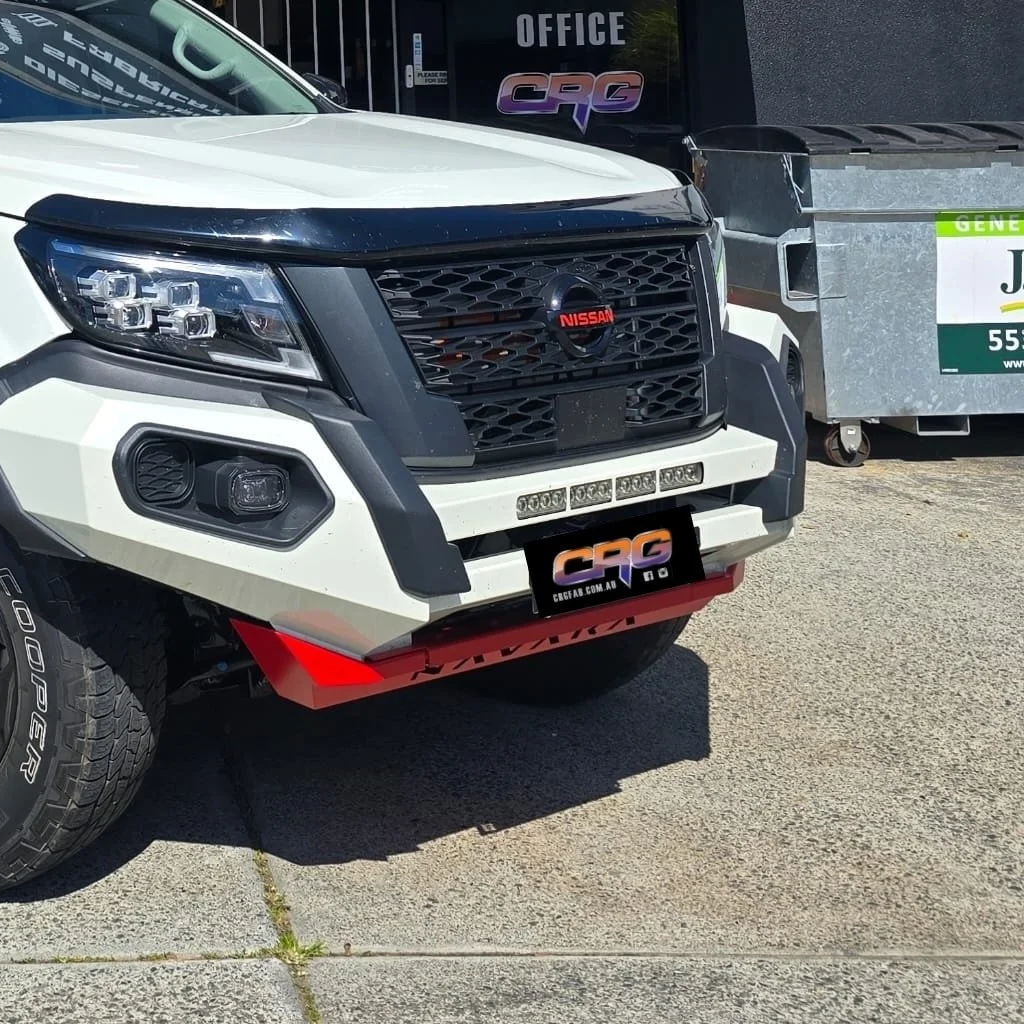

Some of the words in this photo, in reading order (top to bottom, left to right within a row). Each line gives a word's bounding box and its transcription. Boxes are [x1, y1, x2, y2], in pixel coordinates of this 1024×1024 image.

[516, 12, 626, 47] OFFICE
[497, 71, 644, 135] CRG
[954, 215, 1020, 232] GENE
[559, 307, 614, 328] NISSAN
[1003, 360, 1024, 369] ww
